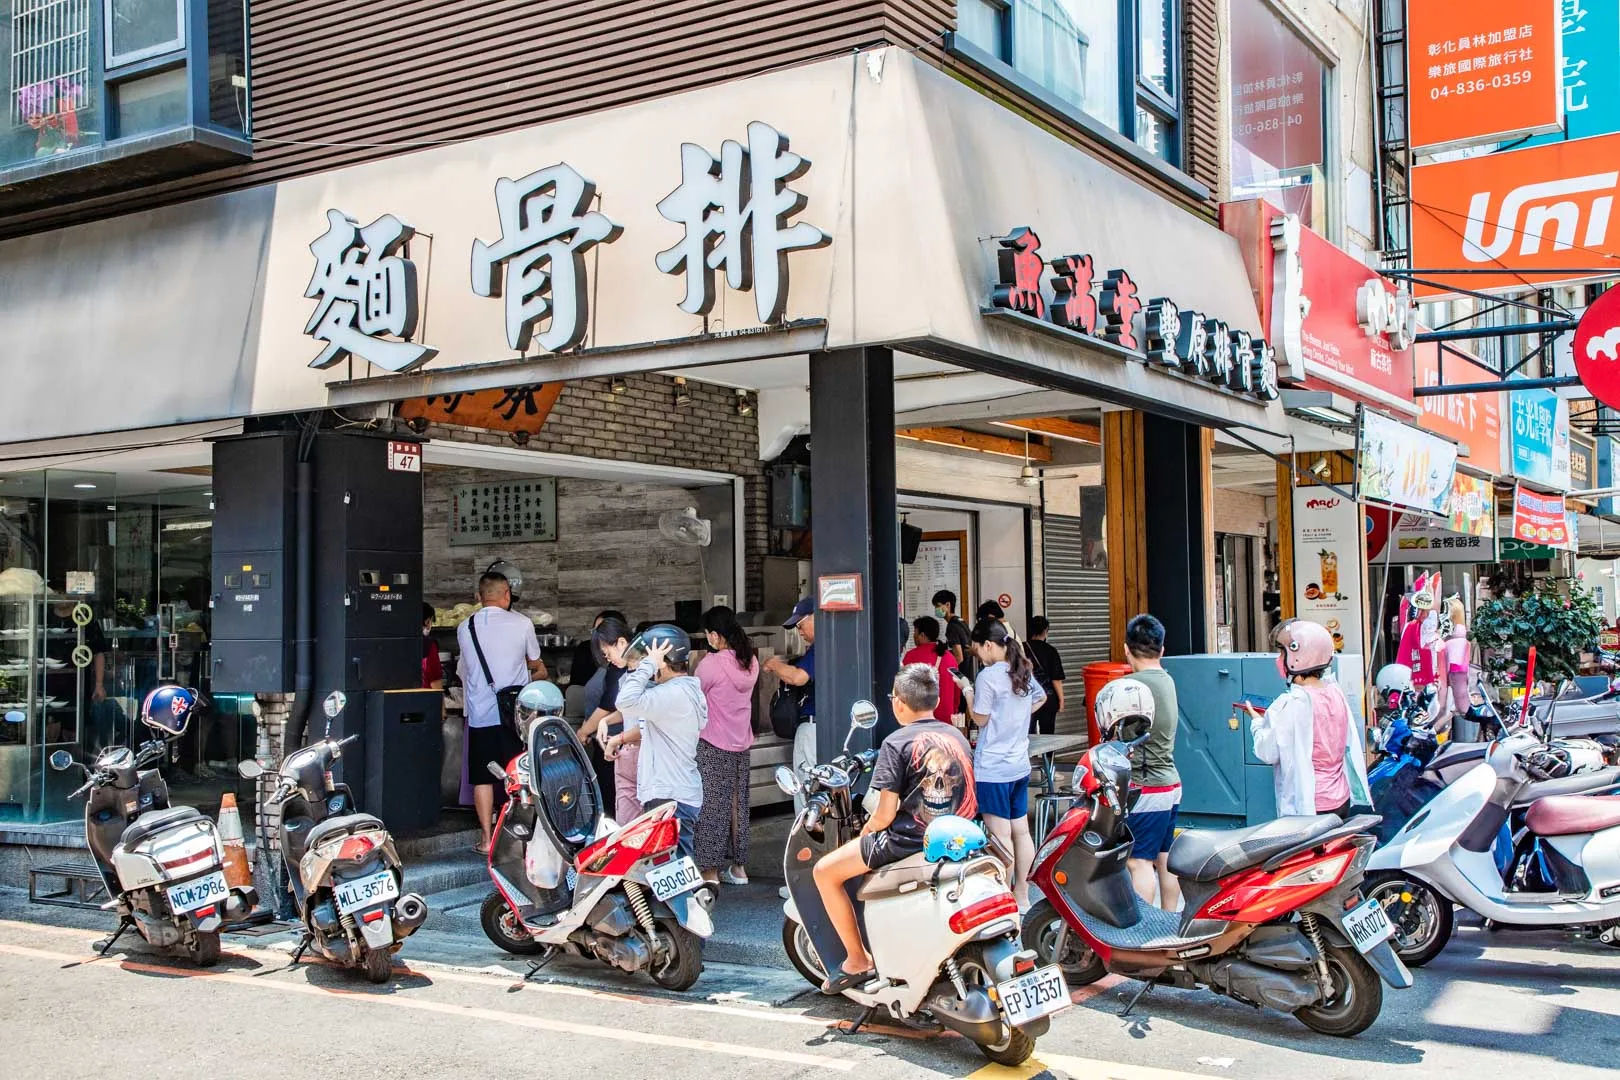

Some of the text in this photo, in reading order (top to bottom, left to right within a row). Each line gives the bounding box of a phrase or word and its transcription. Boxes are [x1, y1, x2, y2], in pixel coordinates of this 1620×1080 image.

[1427, 24, 1533, 57] 彰化員林加盟店
[1428, 46, 1534, 79] 樂旅國際旅行社
[1430, 70, 1532, 100] 04-836-0359
[400, 456, 414, 469] 47
[1430, 536, 1481, 549] 金榜函授
